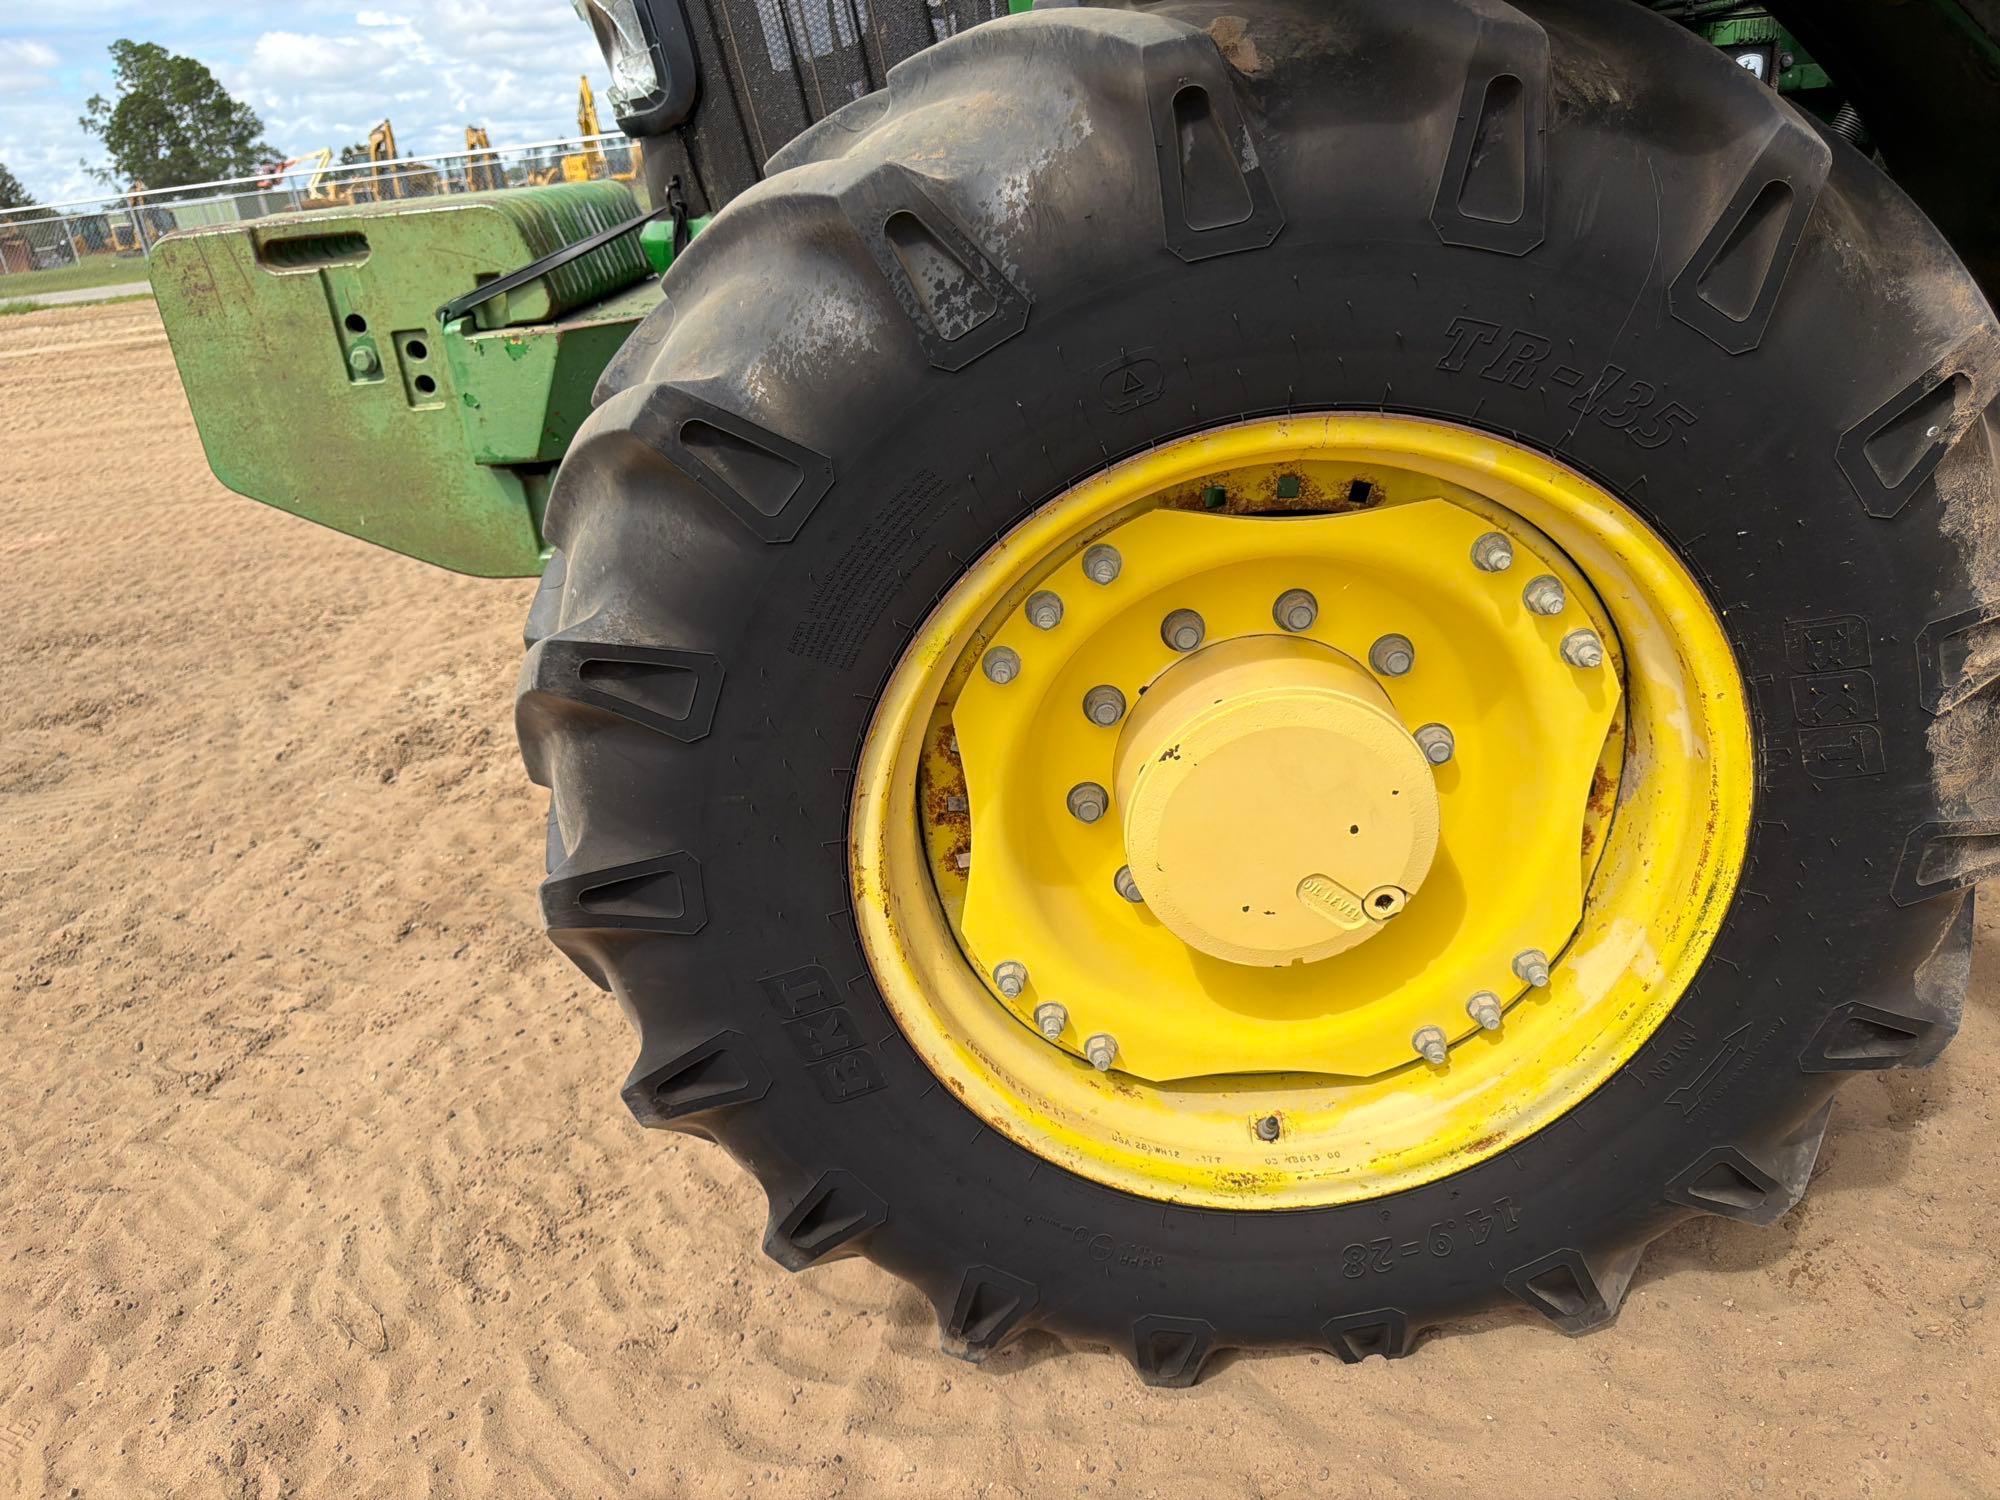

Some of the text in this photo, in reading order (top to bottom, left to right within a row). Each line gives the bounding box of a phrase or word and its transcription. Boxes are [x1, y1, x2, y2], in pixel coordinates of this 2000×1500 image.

[1435, 316, 1698, 449] TR-135
[1303, 880, 1361, 921] OIL LEVEL
[1648, 1032, 1698, 1080] NYLON
[1341, 1195, 1521, 1279] 14.9-28
